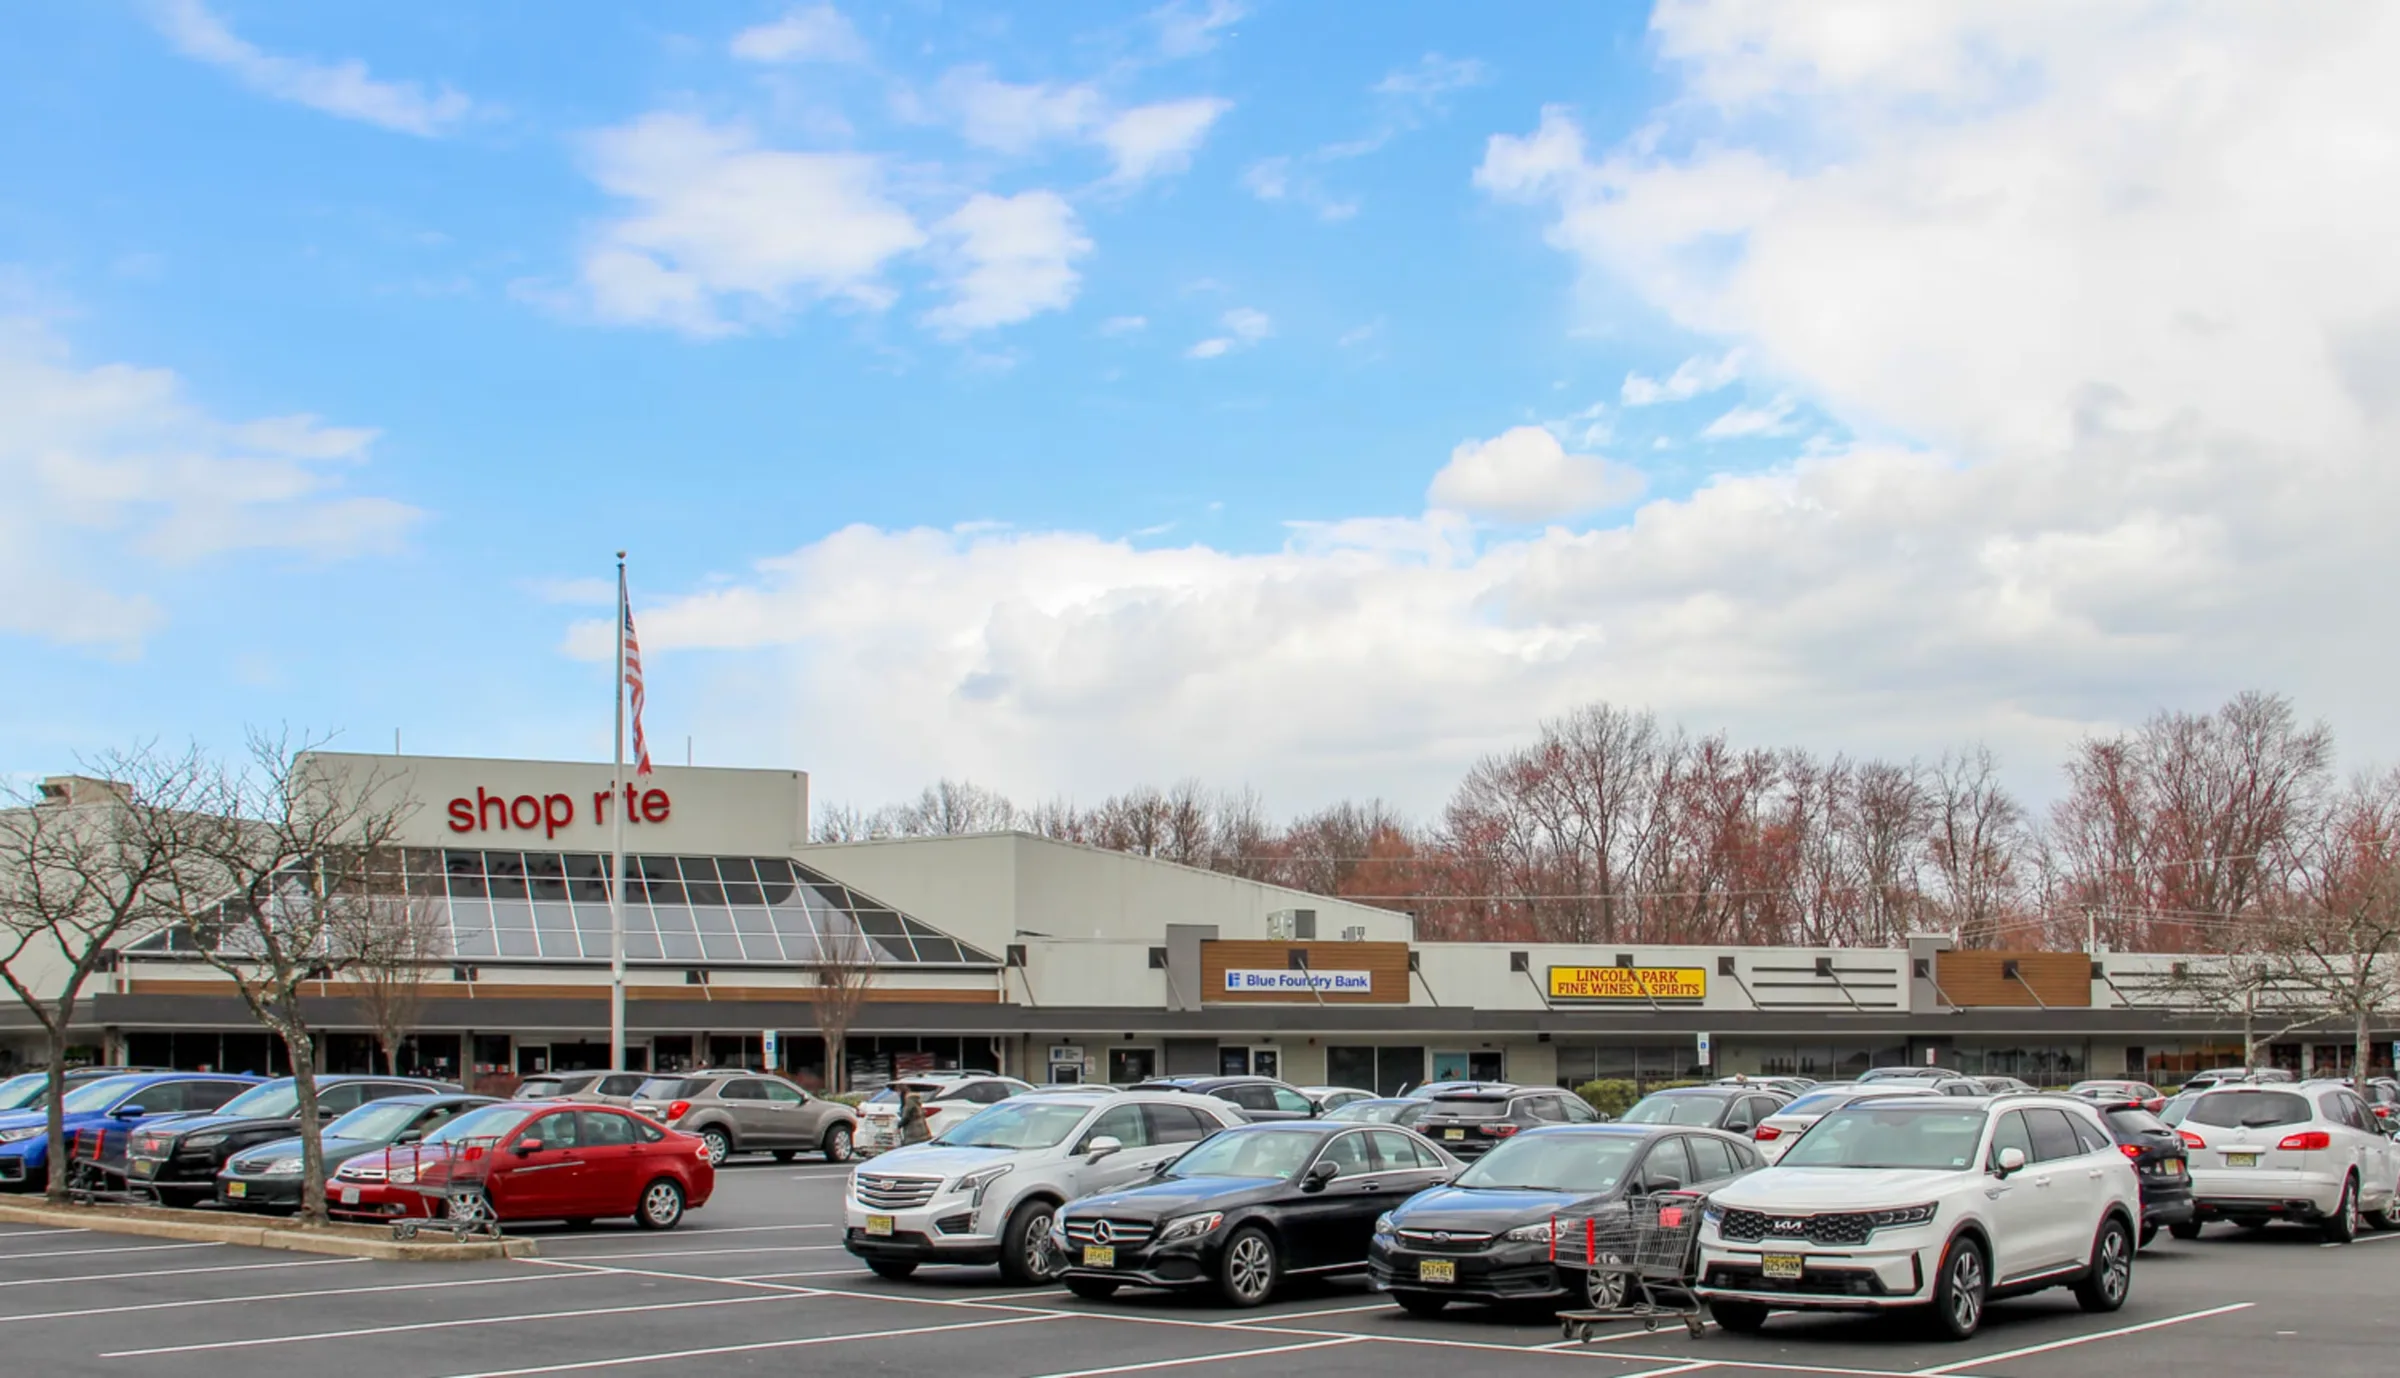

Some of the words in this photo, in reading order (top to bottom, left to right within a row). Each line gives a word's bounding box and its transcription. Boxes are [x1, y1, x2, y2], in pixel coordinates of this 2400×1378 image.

[448, 786, 574, 840] shop
[1246, 974, 1276, 987] Blue
[1279, 974, 1332, 990] Foundry
[1335, 975, 1368, 988] Bank
[1576, 970, 1638, 983] LINCOLN
[1642, 971, 1679, 984] PARK
[1557, 982, 1589, 995] FINE
[1591, 982, 1634, 995] WINES
[1651, 983, 1700, 996] SPIRITS
